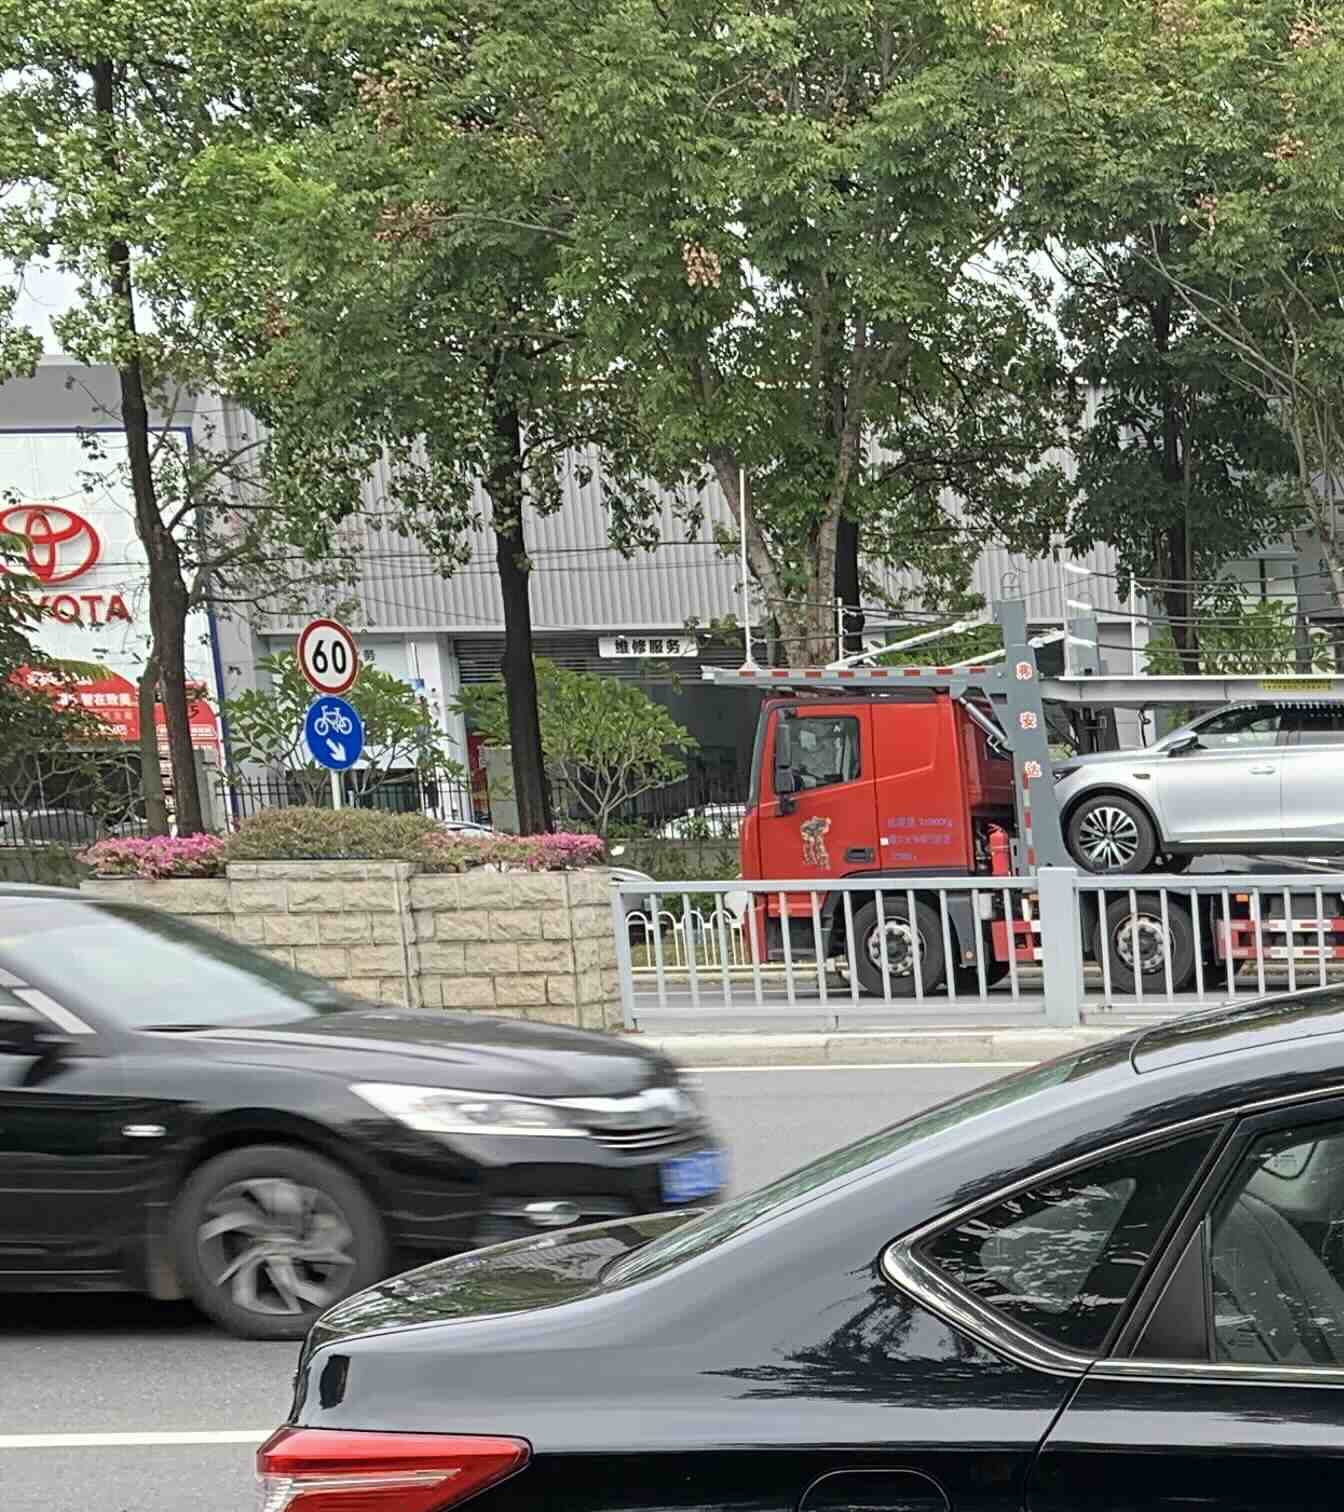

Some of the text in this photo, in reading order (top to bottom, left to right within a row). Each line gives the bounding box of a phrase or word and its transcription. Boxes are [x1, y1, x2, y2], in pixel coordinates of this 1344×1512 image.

[312, 640, 347, 674] 60
[615, 639, 680, 654] 维修服务
